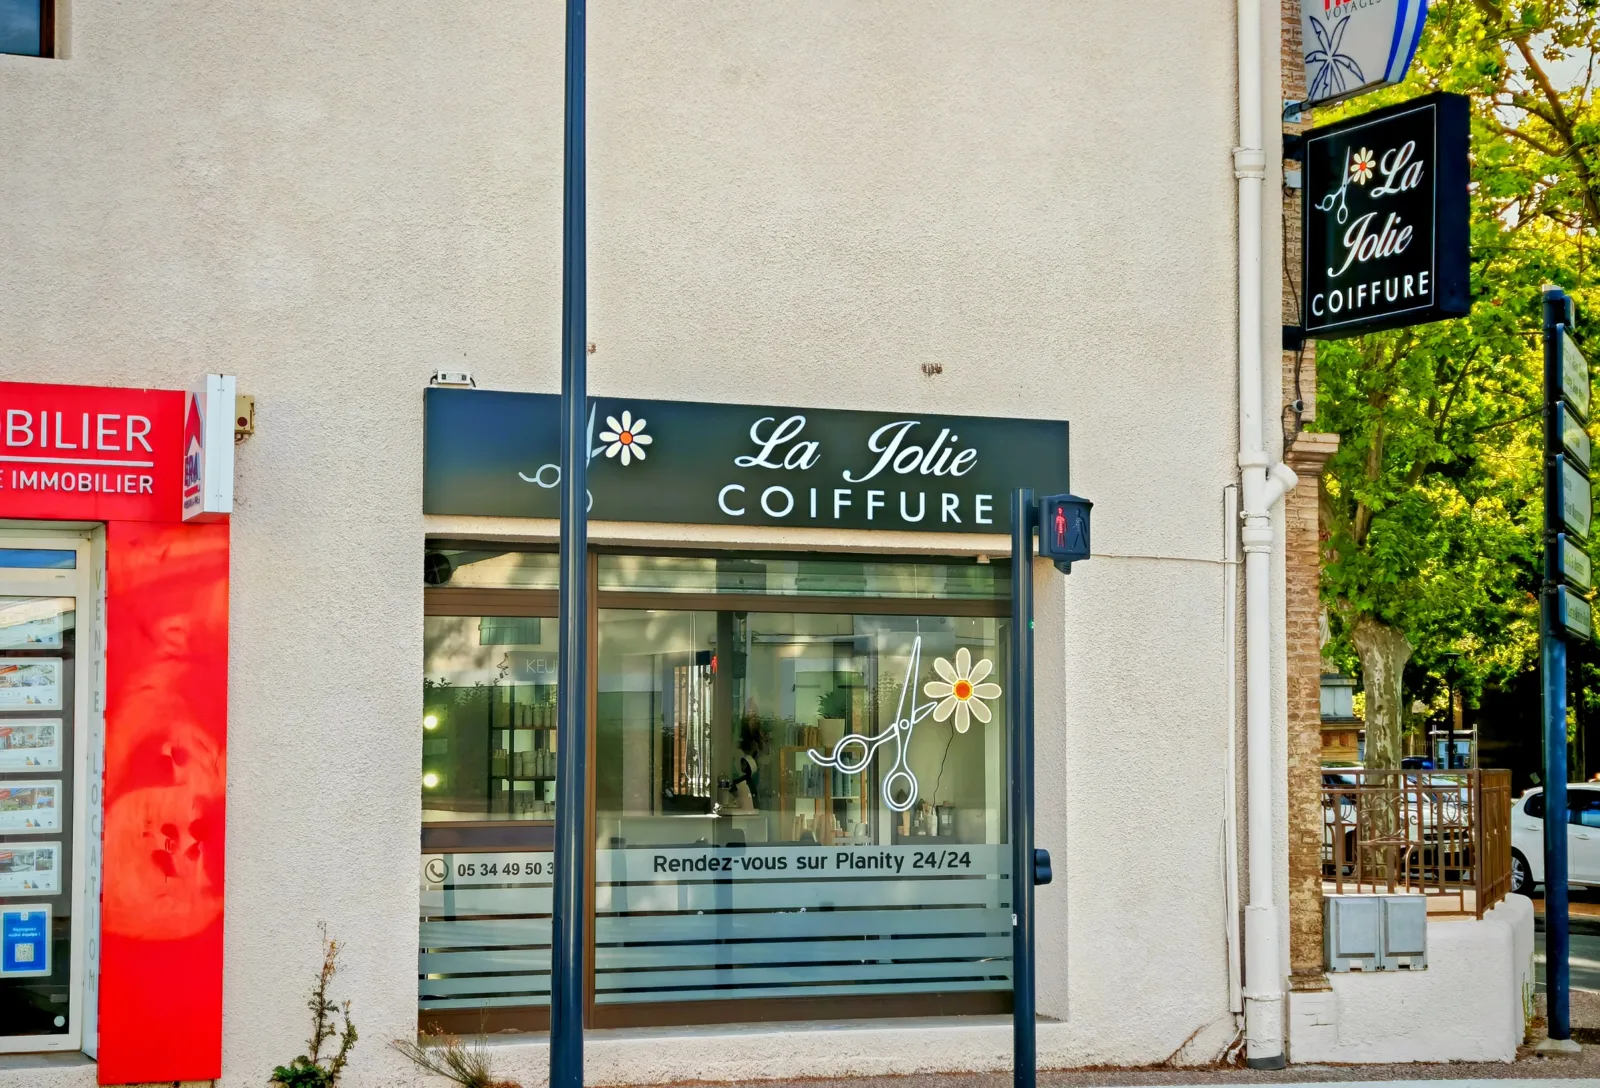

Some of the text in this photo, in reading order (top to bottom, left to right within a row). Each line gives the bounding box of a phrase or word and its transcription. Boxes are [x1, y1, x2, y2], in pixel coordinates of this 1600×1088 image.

[1370, 140, 1424, 199] La
[1327, 211, 1413, 277] Jolie
[1311, 270, 1430, 317] COIFFURE
[0, 408, 153, 453] BILIER
[734, 415, 978, 483] La Jolie
[12, 470, 153, 494] IMMOBILIER
[718, 483, 994, 526] COIFFURE
[457, 863, 476, 877] 05
[480, 862, 498, 876] 34
[502, 862, 520, 876] 49
[524, 861, 542, 876] 50
[653, 850, 972, 874] Rendez-vous sur Planity 24/24
